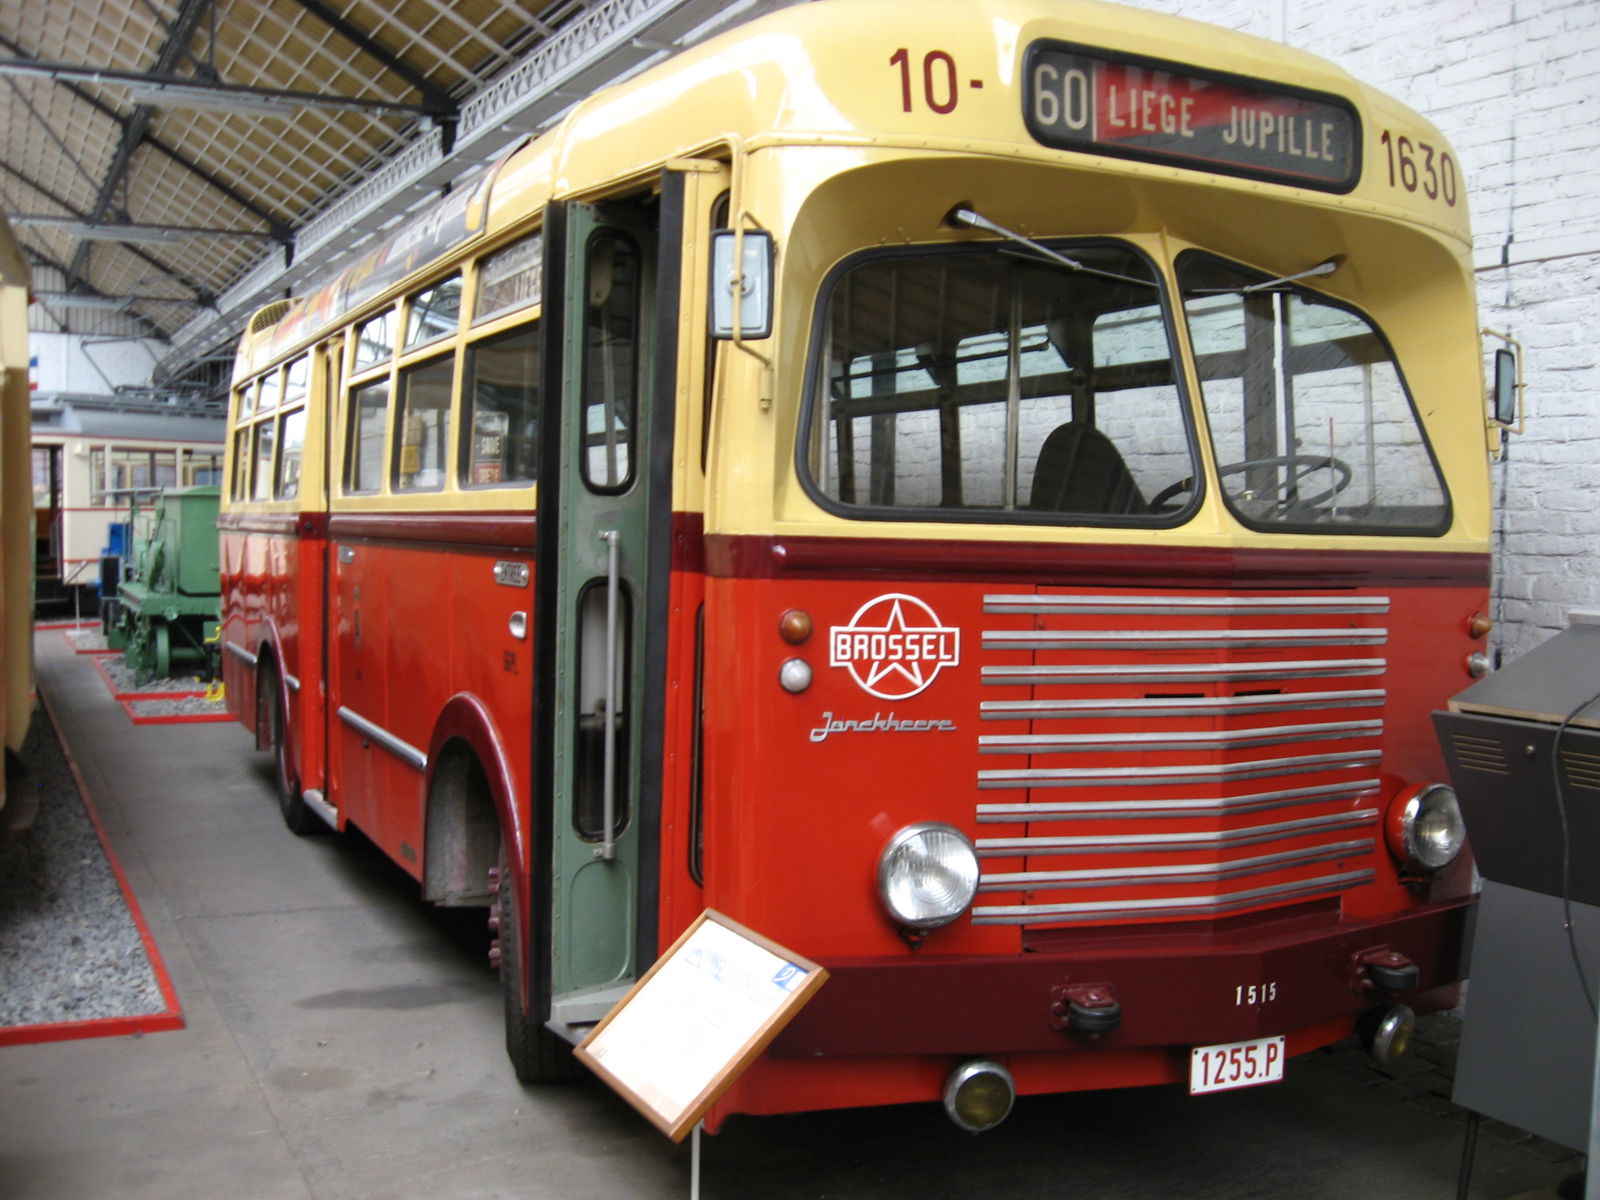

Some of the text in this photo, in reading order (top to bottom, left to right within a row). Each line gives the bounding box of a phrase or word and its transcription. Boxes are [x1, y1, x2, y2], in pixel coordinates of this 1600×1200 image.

[889, 47, 983, 114] 10-
[1034, 63, 1088, 131] 60
[1109, 84, 1334, 162] LIEGE JUPILLE
[1381, 130, 1457, 208] 1630
[836, 633, 953, 661] BROSSEL
[809, 711, 957, 742] Jonckheere
[1201, 1043, 1279, 1086] 1255.P
